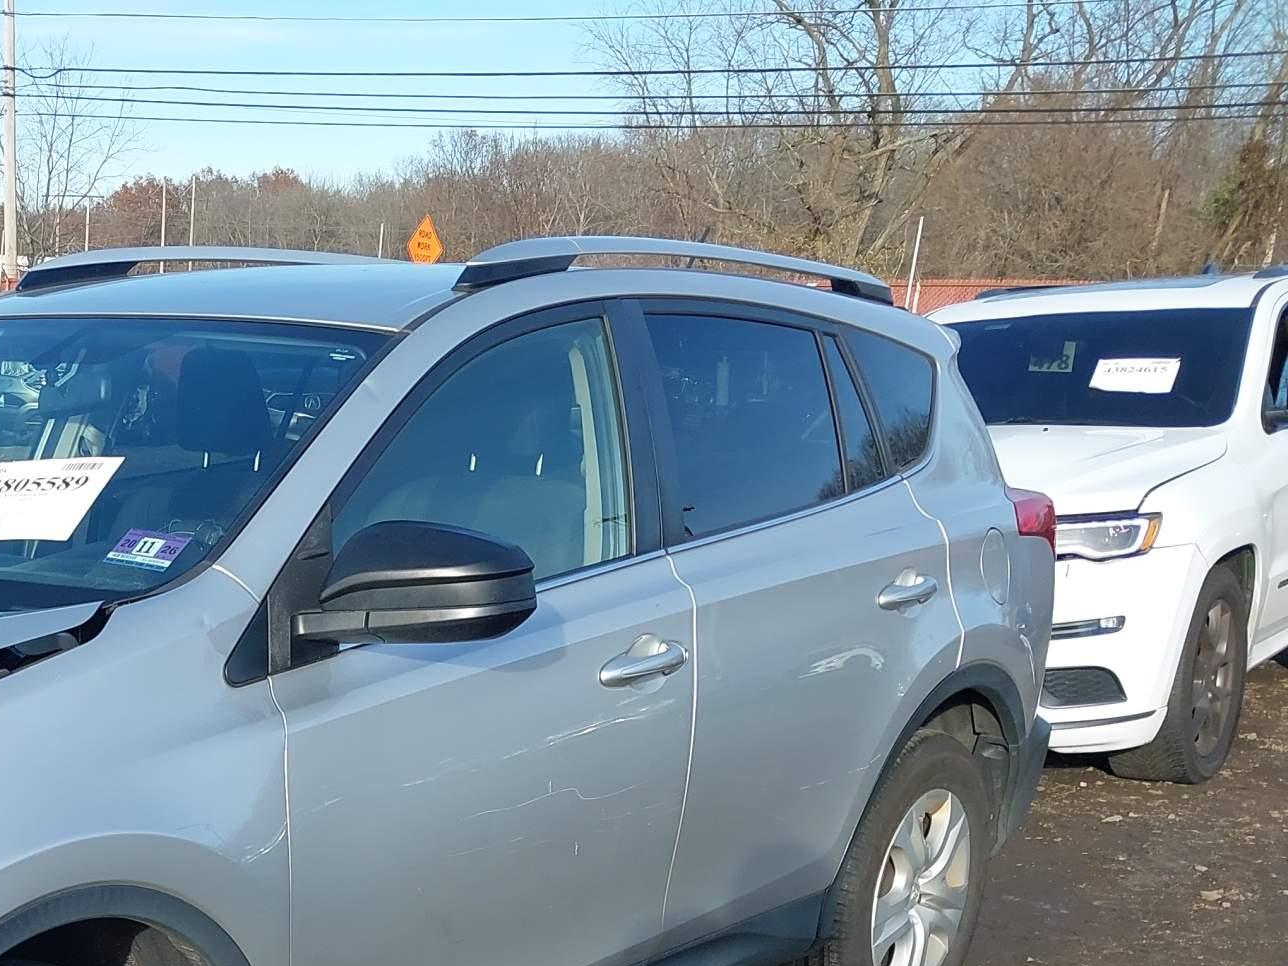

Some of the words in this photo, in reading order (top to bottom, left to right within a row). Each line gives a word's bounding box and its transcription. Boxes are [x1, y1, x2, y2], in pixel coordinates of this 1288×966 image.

[418, 229, 432, 239] ROAD
[417, 242, 431, 250] WORK
[119, 538, 137, 549] 20
[136, 539, 157, 554] 11
[160, 545, 179, 555] 26
